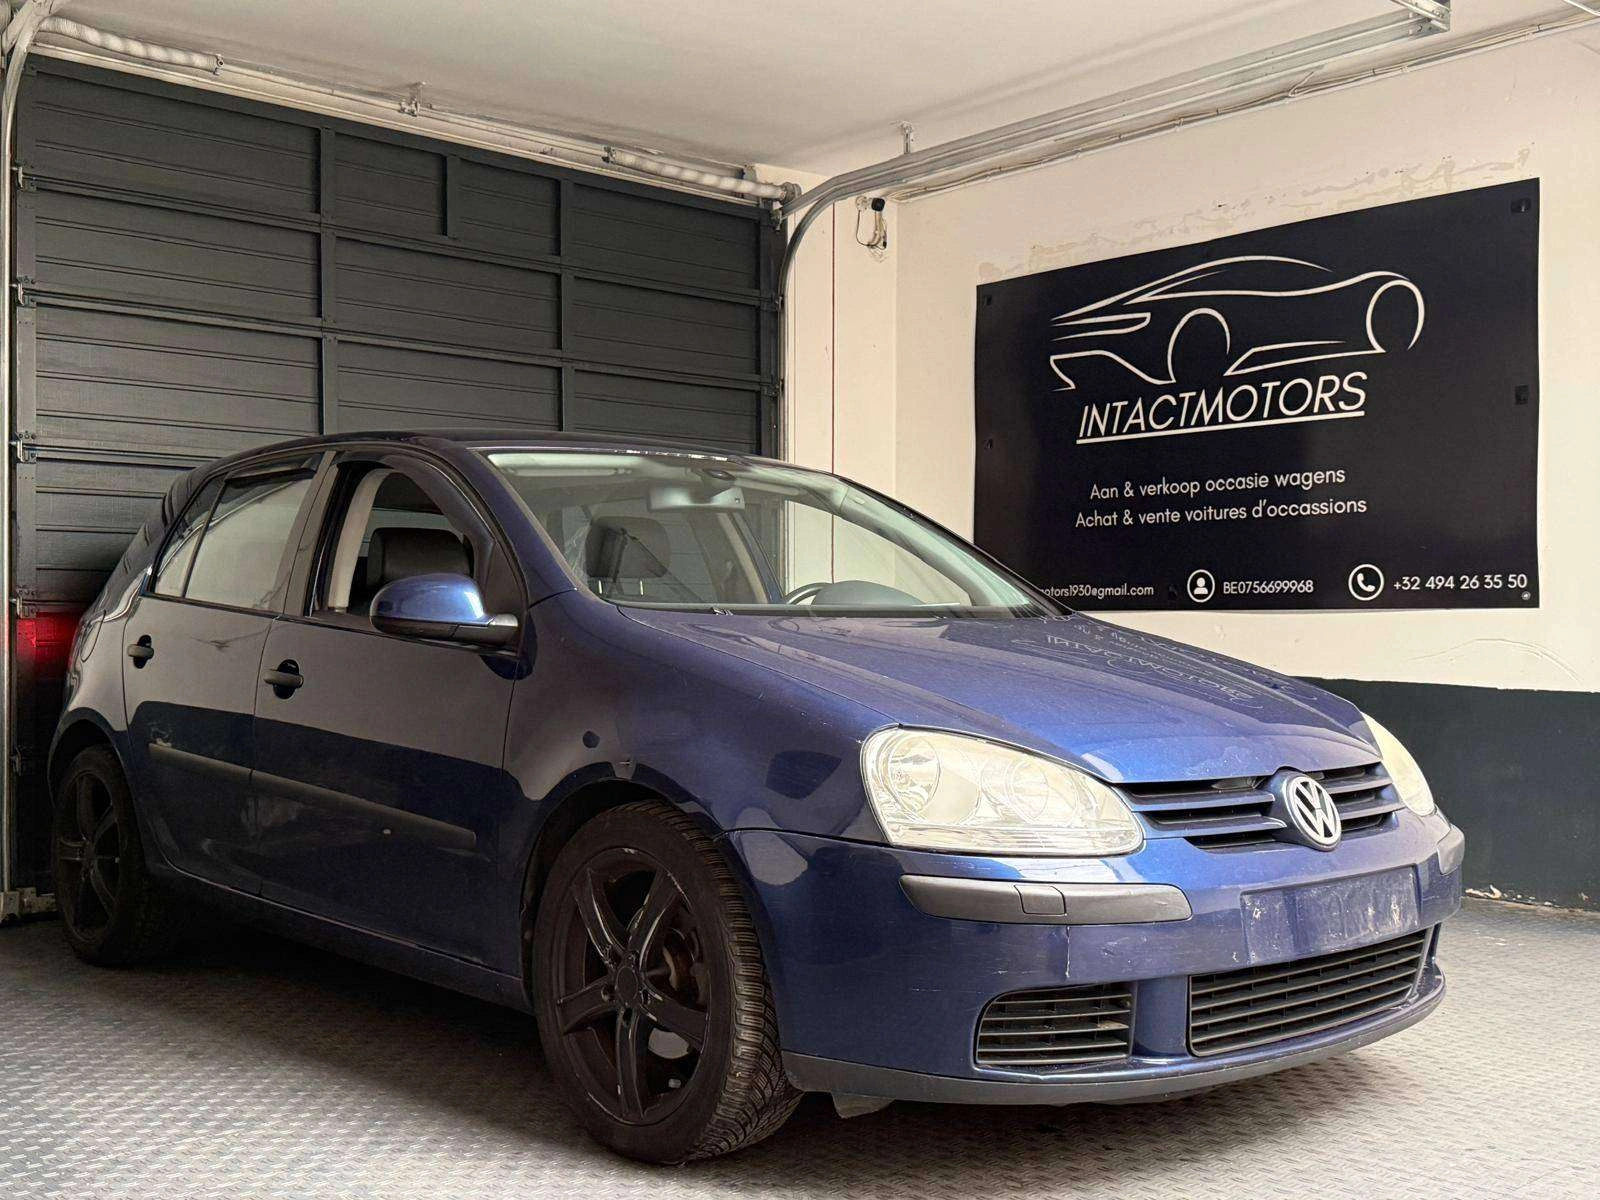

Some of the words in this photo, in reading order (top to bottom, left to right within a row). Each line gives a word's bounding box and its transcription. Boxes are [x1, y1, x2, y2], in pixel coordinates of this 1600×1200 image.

[1079, 371, 1368, 437] INTACTMOTORS
[1090, 484, 1119, 500] Aan
[1123, 481, 1135, 498] &
[1139, 477, 1201, 499] verkoop
[1205, 473, 1269, 492] occasie
[1274, 467, 1346, 490] wagens
[1075, 510, 1118, 528] Achat
[1122, 509, 1134, 526] &
[1138, 508, 1181, 525] vente
[1184, 506, 1247, 522] voitures
[1251, 498, 1368, 518] d'occassions
[1223, 579, 1314, 594] BE0756699968
[1393, 575, 1421, 591] +32
[1425, 575, 1456, 590] 494
[1459, 574, 1480, 590] 26
[1483, 574, 1503, 589] 35
[1507, 573, 1528, 589] 50
